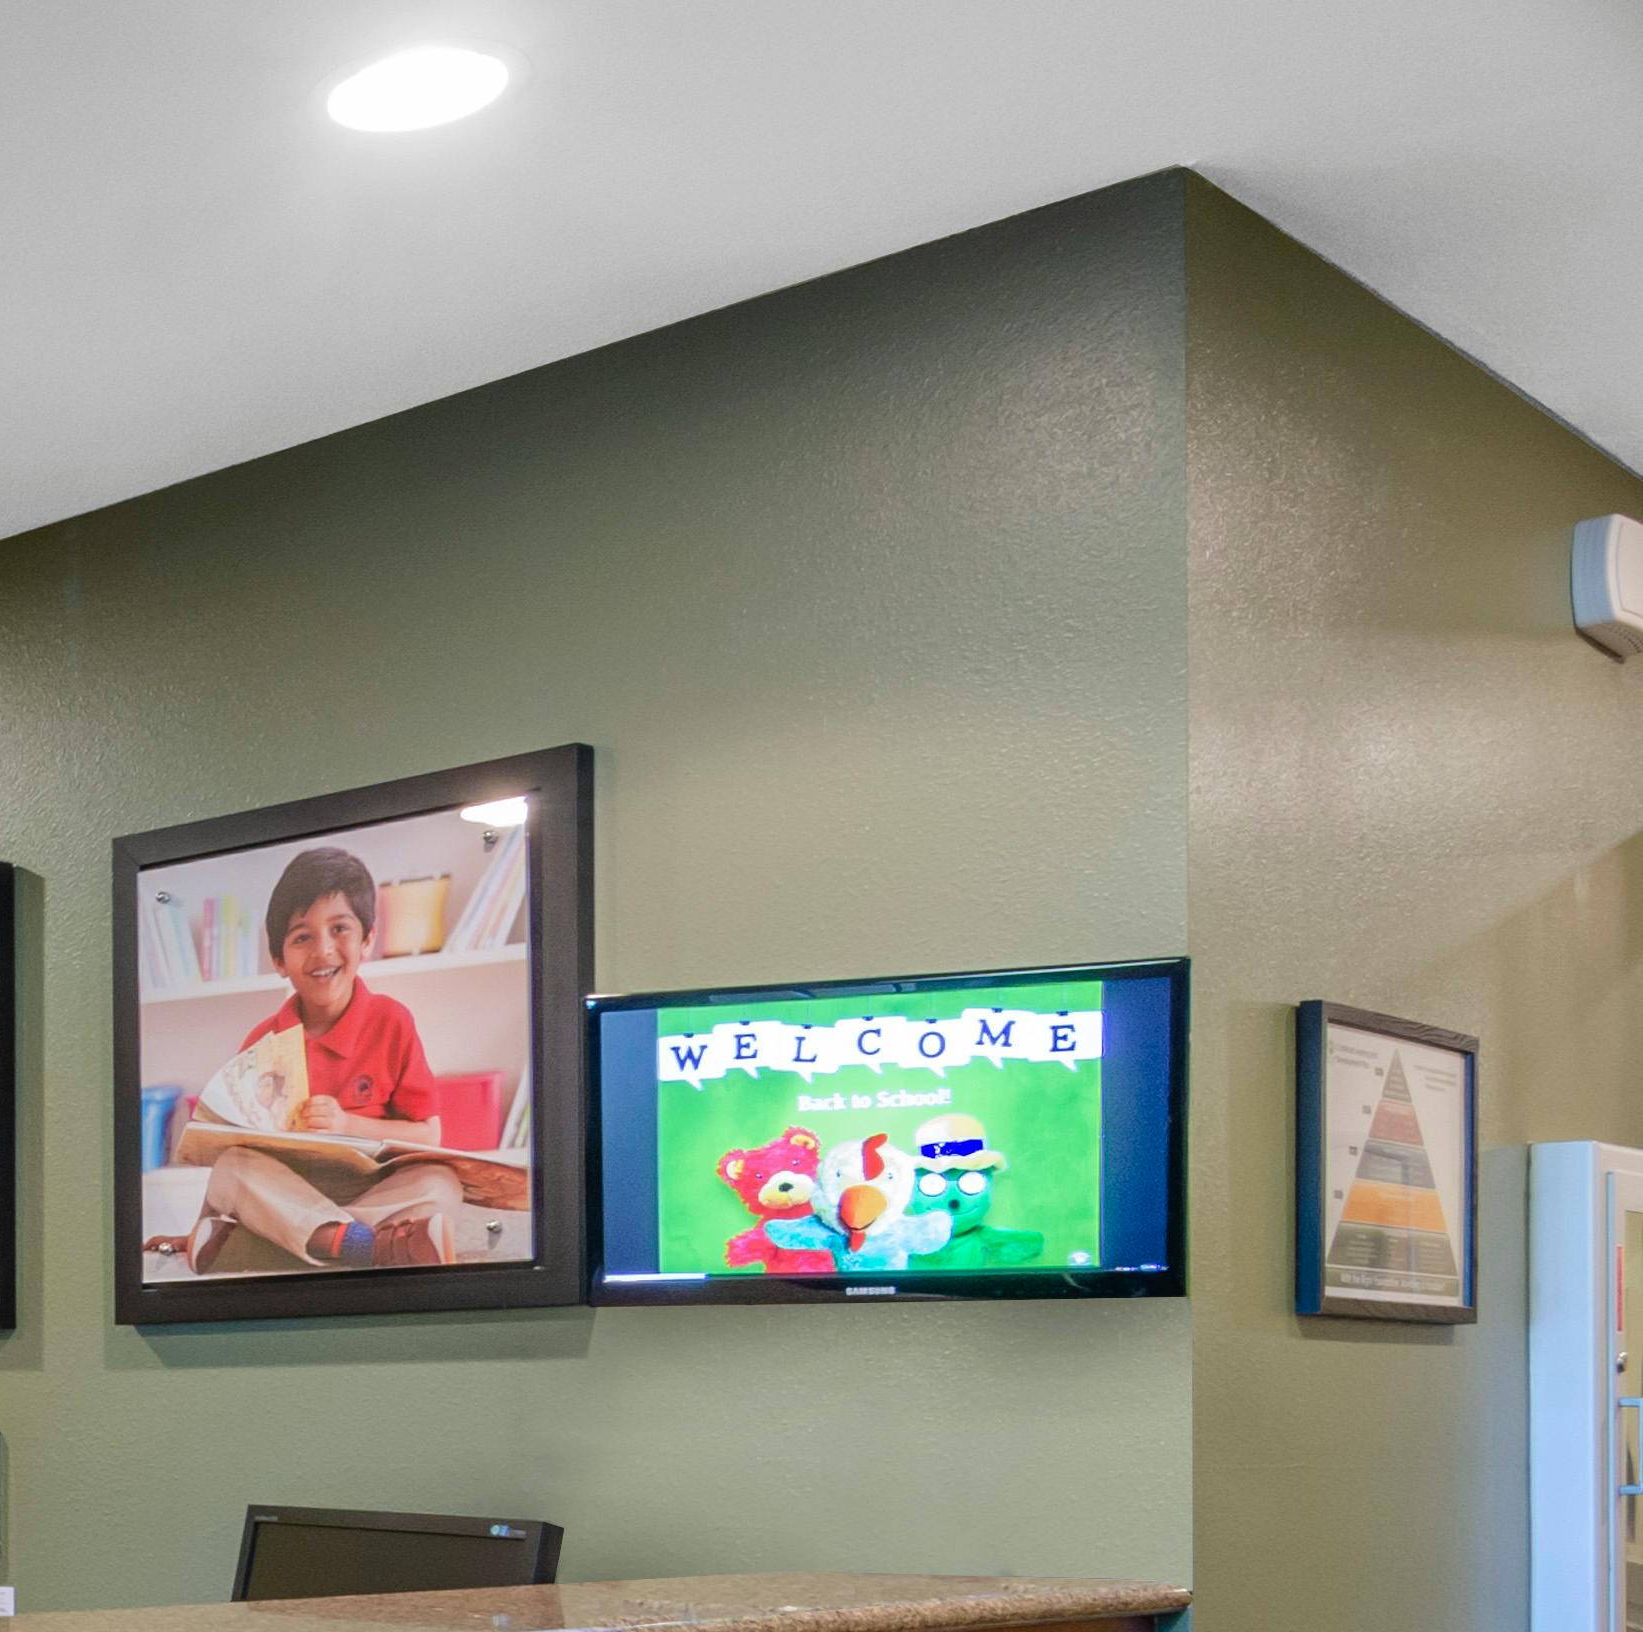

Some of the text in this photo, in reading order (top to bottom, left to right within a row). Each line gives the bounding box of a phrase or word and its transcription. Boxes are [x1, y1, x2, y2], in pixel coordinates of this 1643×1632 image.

[669, 1019, 1077, 1071] WELCOME
[796, 1088, 952, 1112] Back to School!
